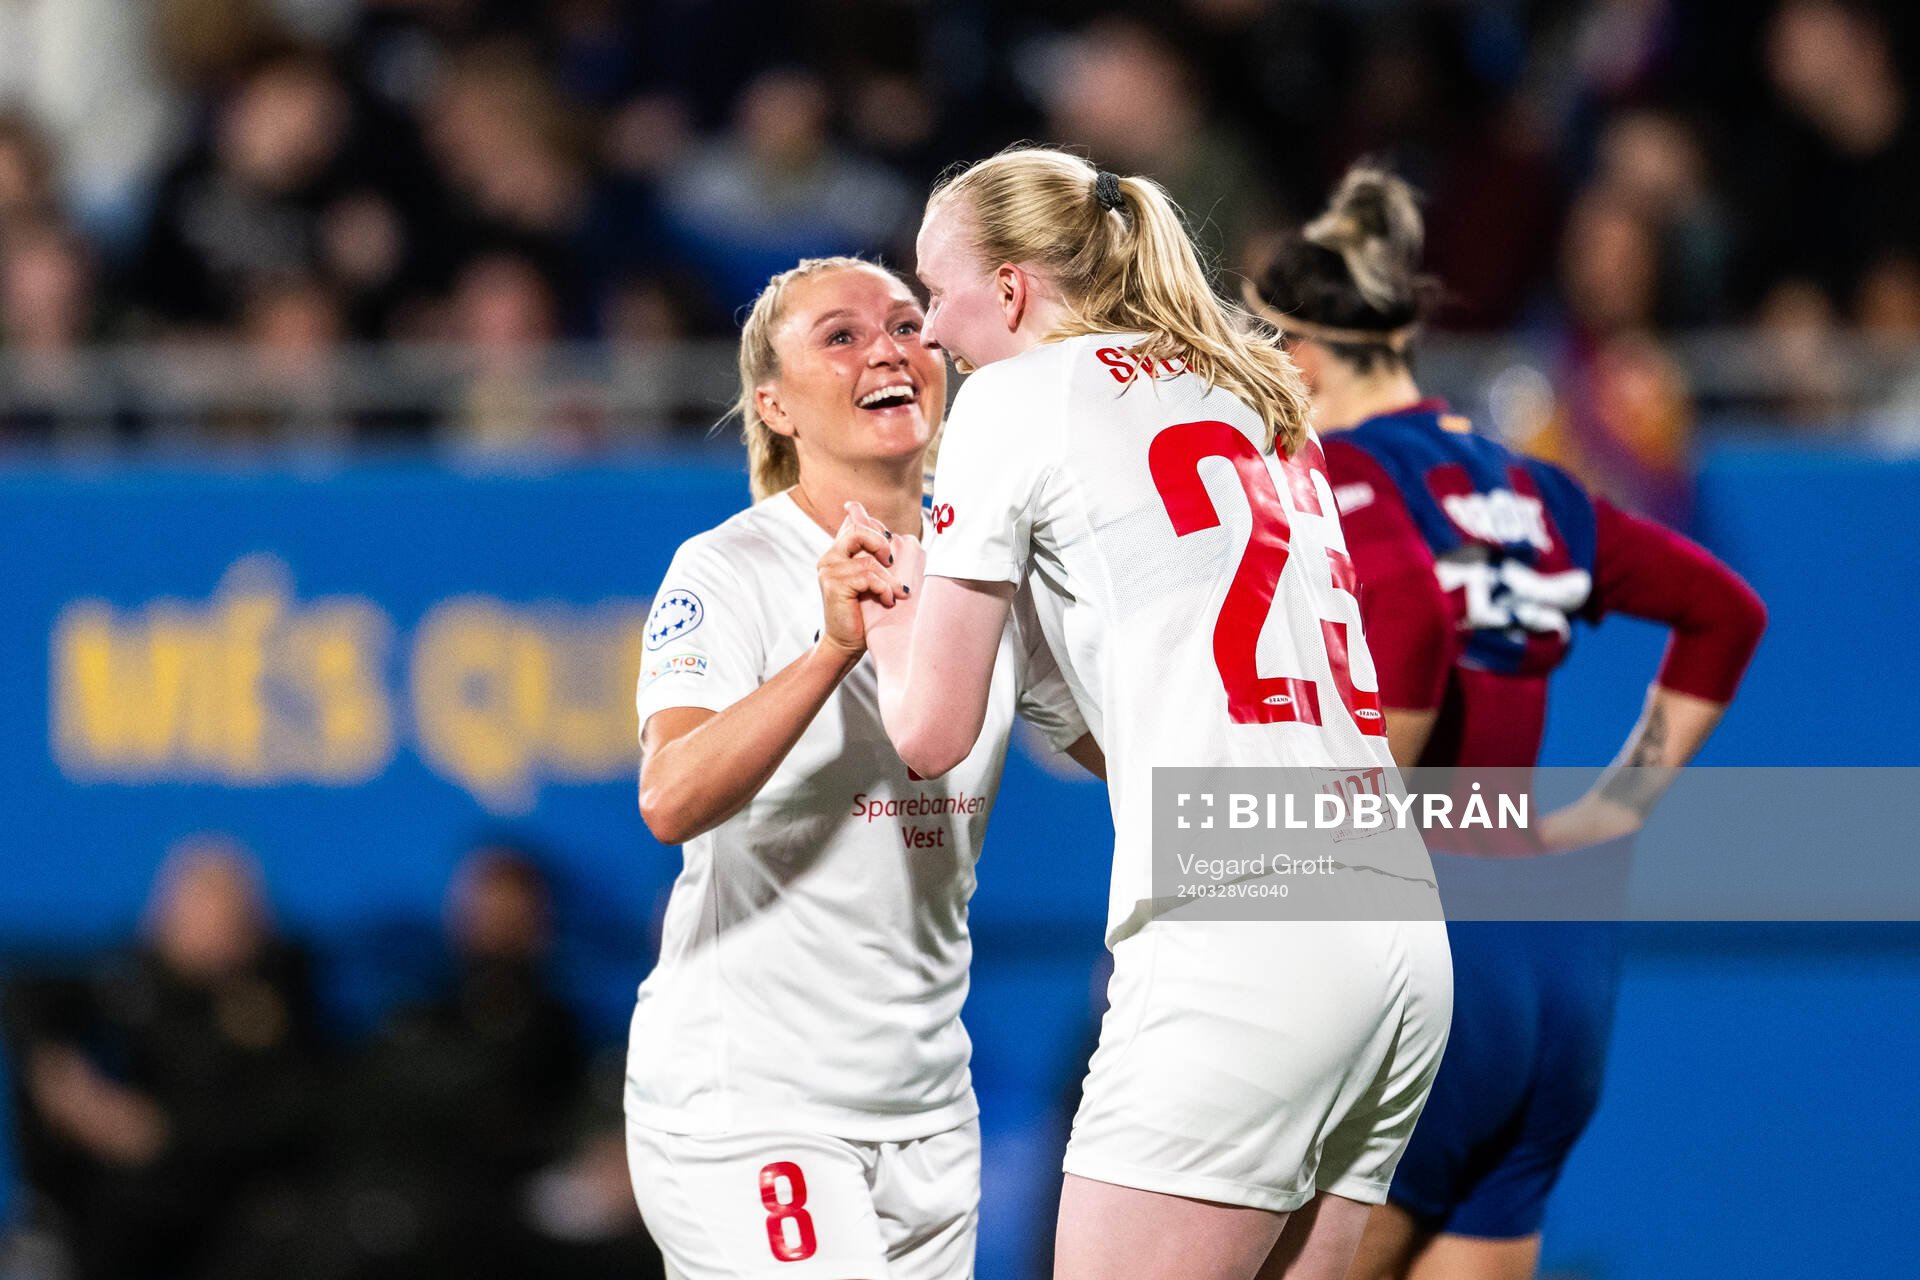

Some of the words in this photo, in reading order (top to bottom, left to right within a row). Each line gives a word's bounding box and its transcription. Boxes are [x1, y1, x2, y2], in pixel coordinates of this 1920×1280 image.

[1148, 420, 1388, 738] 23
[852, 792, 986, 823] Sparebanken
[902, 826, 945, 849] Vest
[758, 1161, 818, 1263] 8
